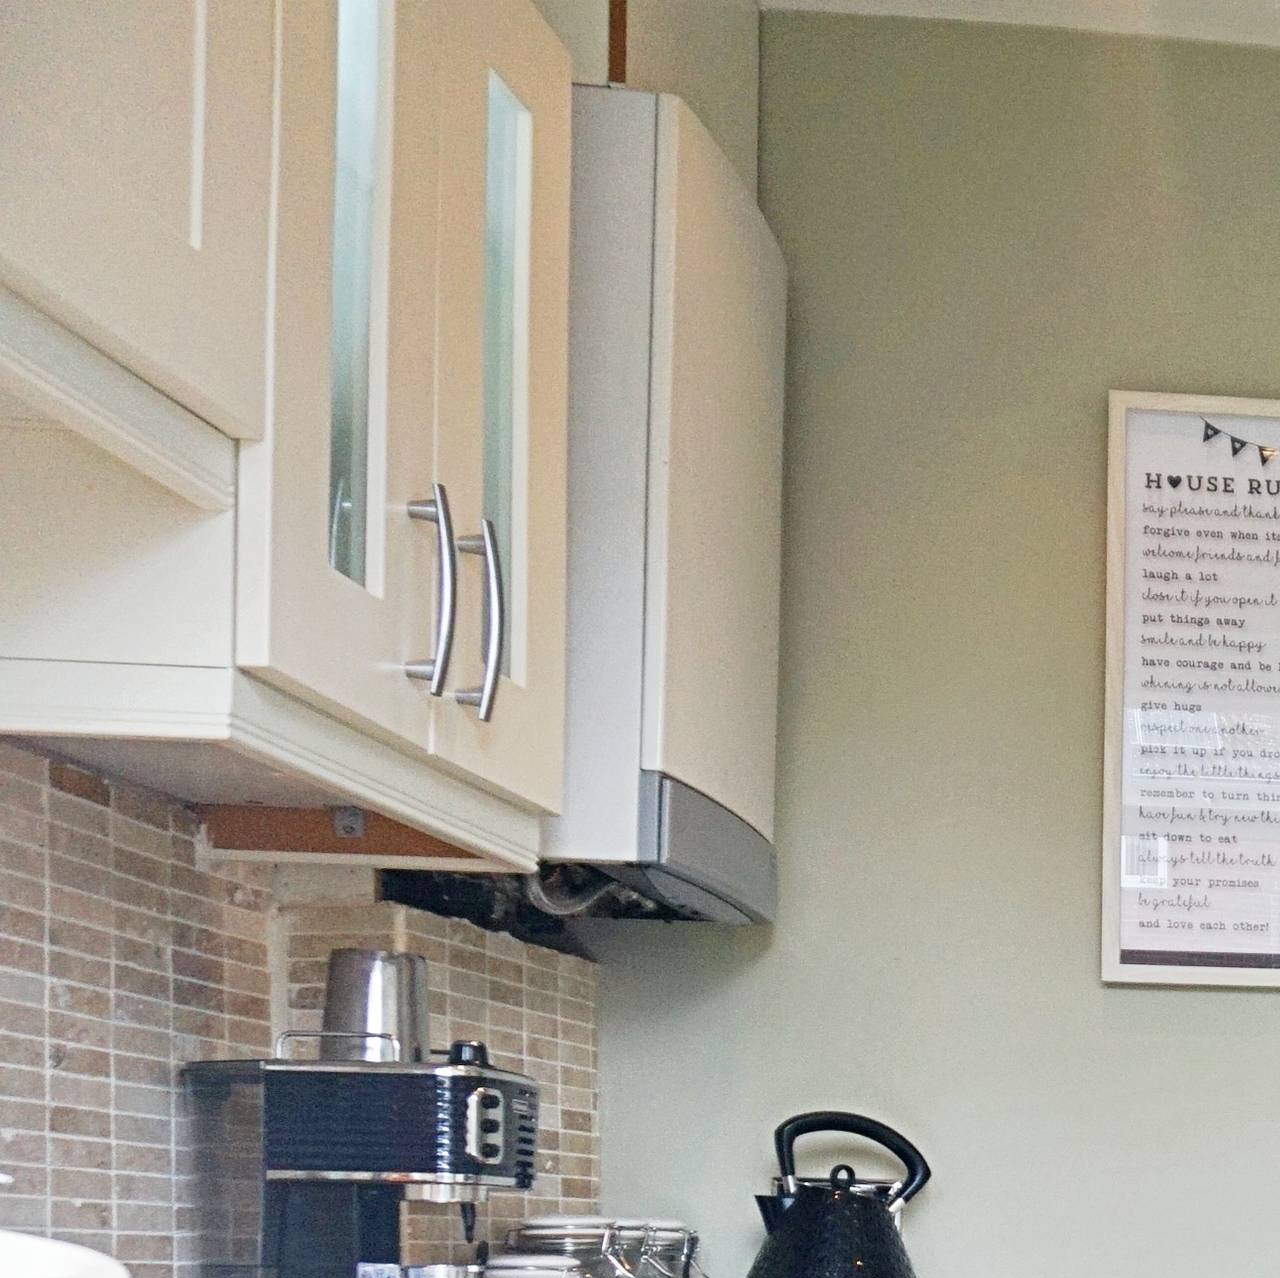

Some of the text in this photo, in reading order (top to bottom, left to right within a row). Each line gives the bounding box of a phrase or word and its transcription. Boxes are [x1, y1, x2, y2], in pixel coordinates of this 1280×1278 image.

[1142, 503, 1167, 518] say
[1169, 502, 1213, 518] please
[1214, 504, 1240, 518] and
[1243, 505, 1280, 520] thank
[1143, 525, 1190, 538] forgive
[1196, 530, 1223, 539] even
[1230, 530, 1258, 540] when
[1142, 544, 1194, 559] welcome
[1194, 546, 1244, 563] friends
[1247, 549, 1272, 563] and
[1142, 568, 1178, 582] laugh
[1199, 571, 1218, 581] lot
[1142, 587, 1278, 609] close it if you open it
[1142, 613, 1246, 628] put things away
[1140, 631, 1266, 652] smile and be happy
[1141, 656, 1170, 668] have
[1176, 660, 1224, 672] courage
[1230, 661, 1251, 671] and
[1258, 661, 1272, 671] be
[1140, 675, 1196, 693] whining
[1198, 680, 1212, 691] is
[1213, 678, 1236, 692] not
[1140, 700, 1202, 714] give hugs
[1140, 744, 1167, 756] pick
[1173, 745, 1185, 755] it
[1192, 747, 1206, 758] up
[1213, 747, 1226, 757] if
[1232, 749, 1253, 760] you
[1139, 788, 1196, 799] remember
[1202, 790, 1215, 800] to
[1221, 791, 1249, 800] turn
[1138, 805, 1169, 820] have
[1169, 806, 1196, 824] fun
[1207, 808, 1230, 826] try
[1234, 814, 1259, 823] new
[1138, 831, 1239, 844] sit down to eat
[1190, 851, 1216, 866] tell
[1216, 851, 1238, 866] the
[1238, 853, 1277, 867] truth
[1172, 877, 1201, 888] your
[1208, 878, 1260, 889] promises
[1152, 893, 1211, 911] grateful
[1138, 919, 1269, 932] and love each other!
